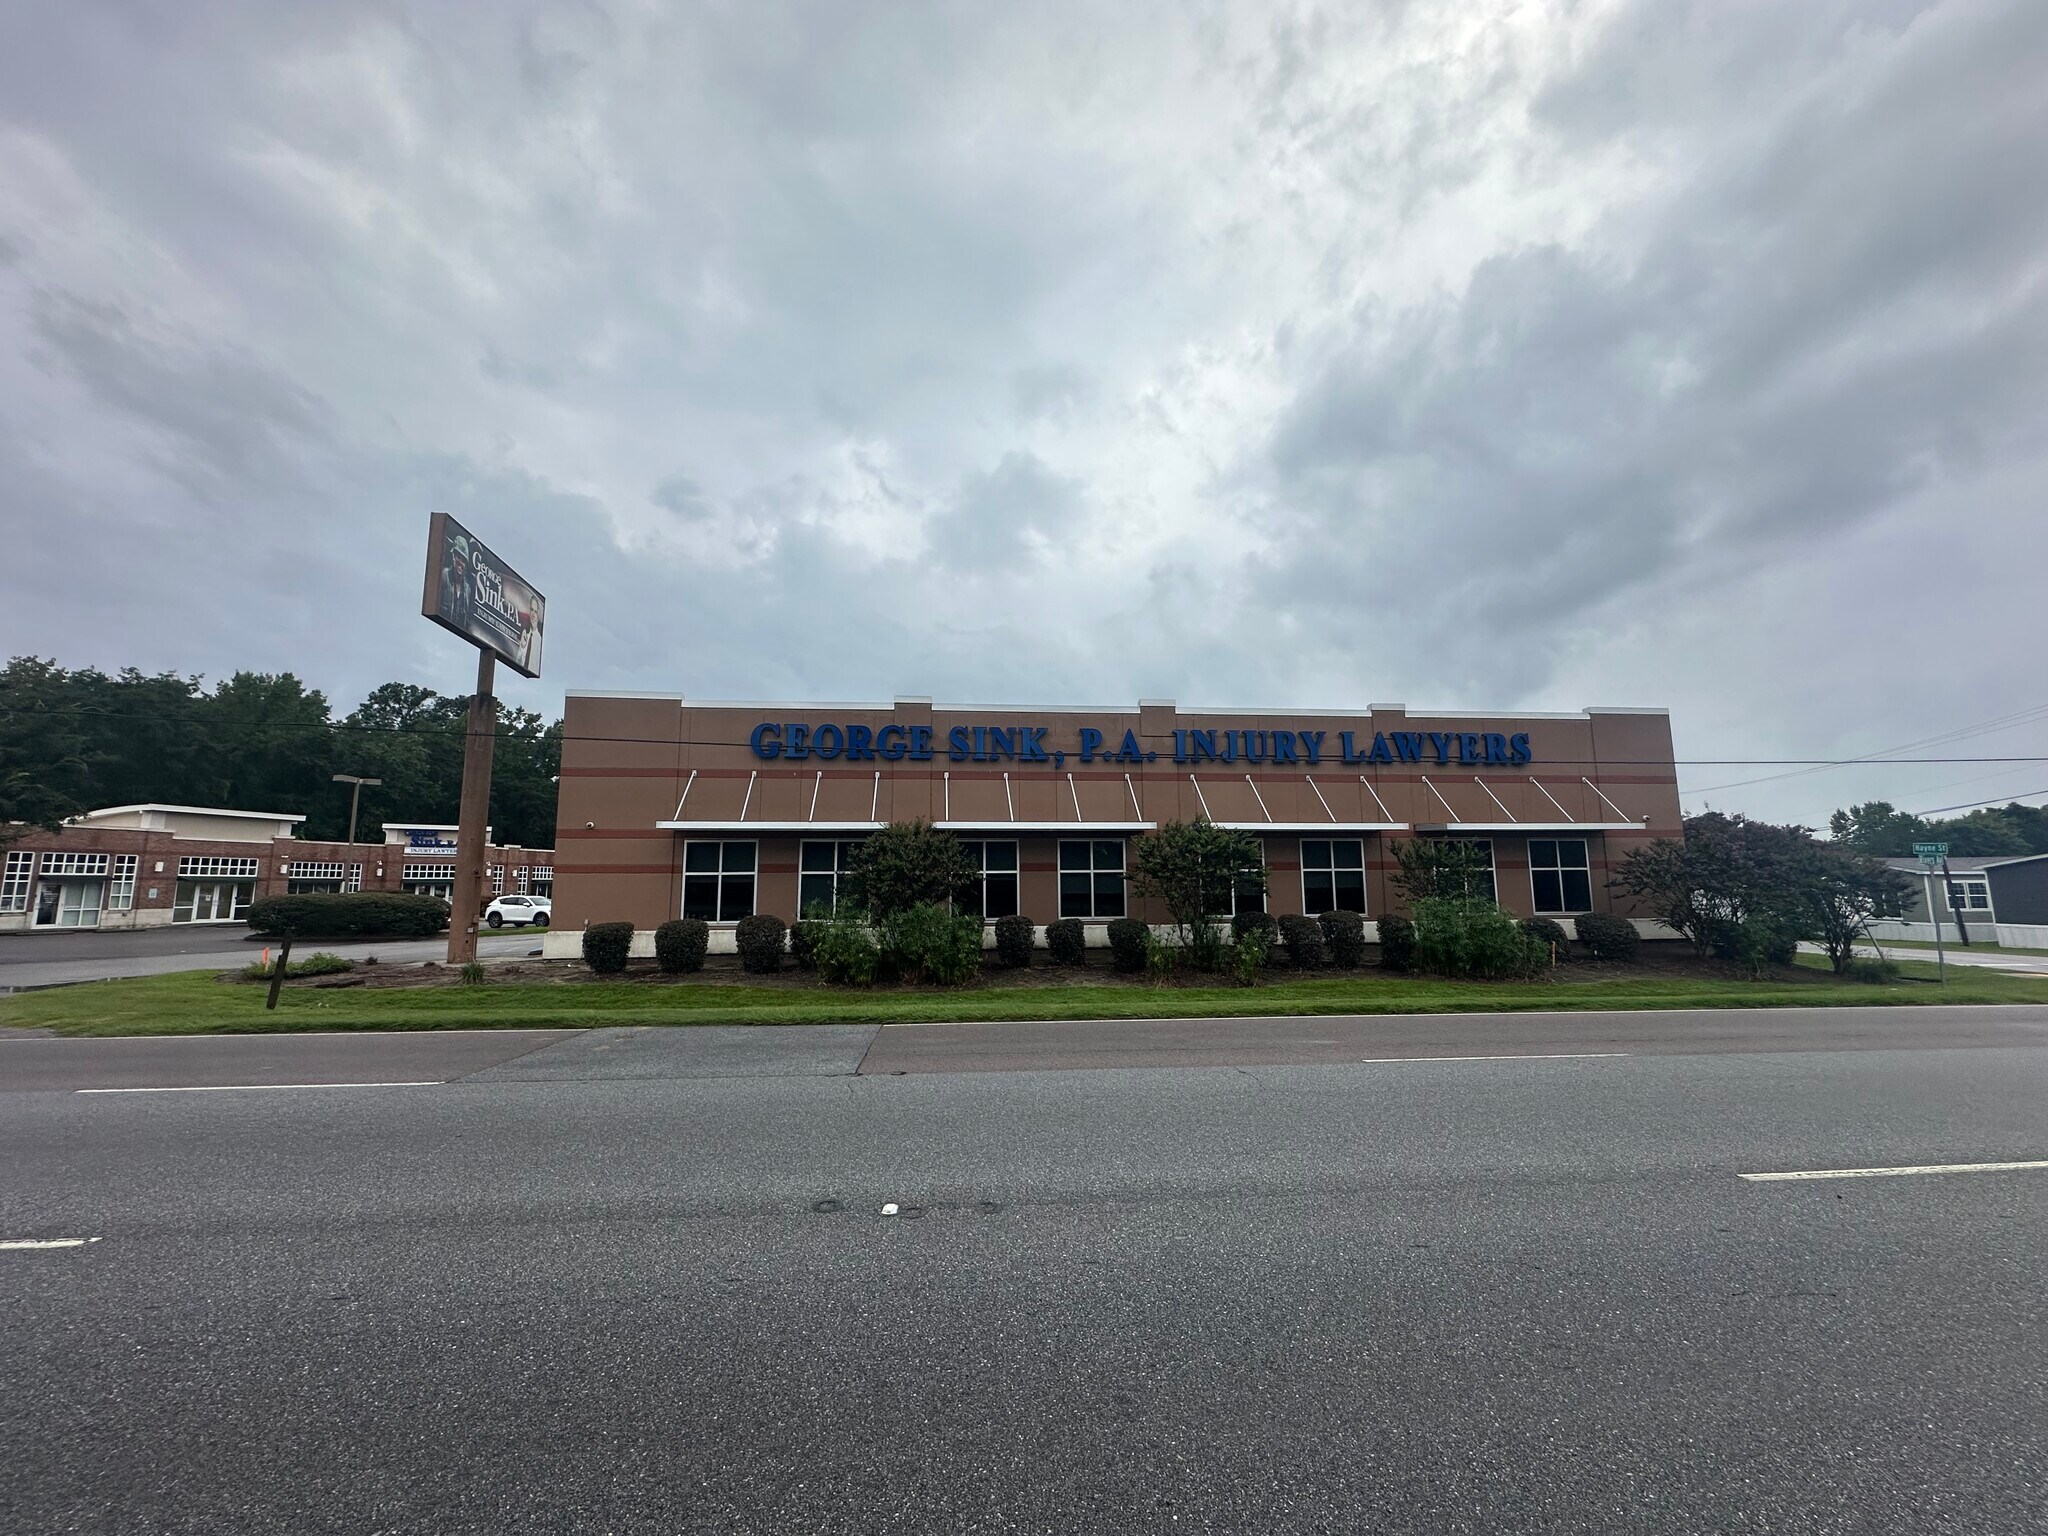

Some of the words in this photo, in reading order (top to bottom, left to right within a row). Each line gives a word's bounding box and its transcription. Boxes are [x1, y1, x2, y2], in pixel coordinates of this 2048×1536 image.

[750, 723, 934, 761] GEORGE
[949, 725, 1065, 768] SINK,
[1079, 728, 1157, 762] P.A.
[1172, 729, 1326, 764] INJURY
[1338, 731, 1532, 765] LAWYERS
[1915, 844, 1936, 852] Hayne
[1937, 844, 1946, 852] St
